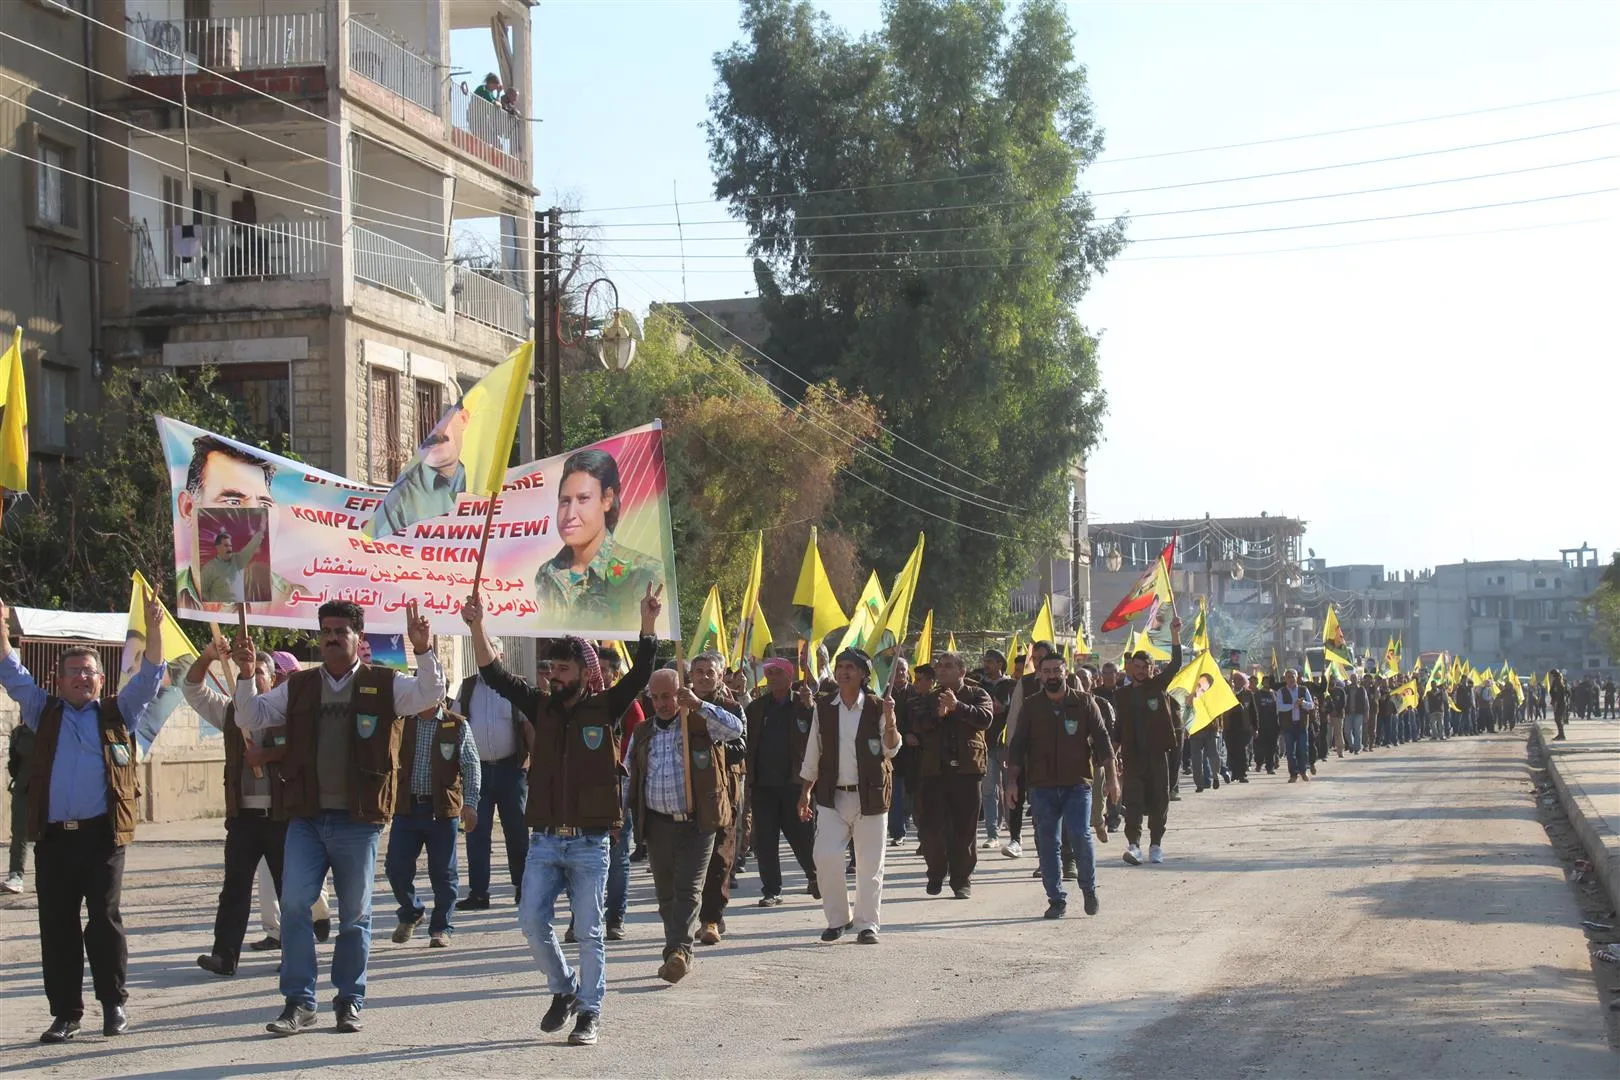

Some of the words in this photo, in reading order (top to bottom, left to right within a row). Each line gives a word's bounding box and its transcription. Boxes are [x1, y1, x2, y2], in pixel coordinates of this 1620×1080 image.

[457, 500, 504, 517] EME
[347, 537, 415, 559] PERCE
[420, 546, 481, 563] BIKIN
[303, 557, 368, 577] سنفشل
[370, 564, 423, 583] عفرين
[422, 567, 476, 586] مقاومة
[480, 577, 524, 592] بروح
